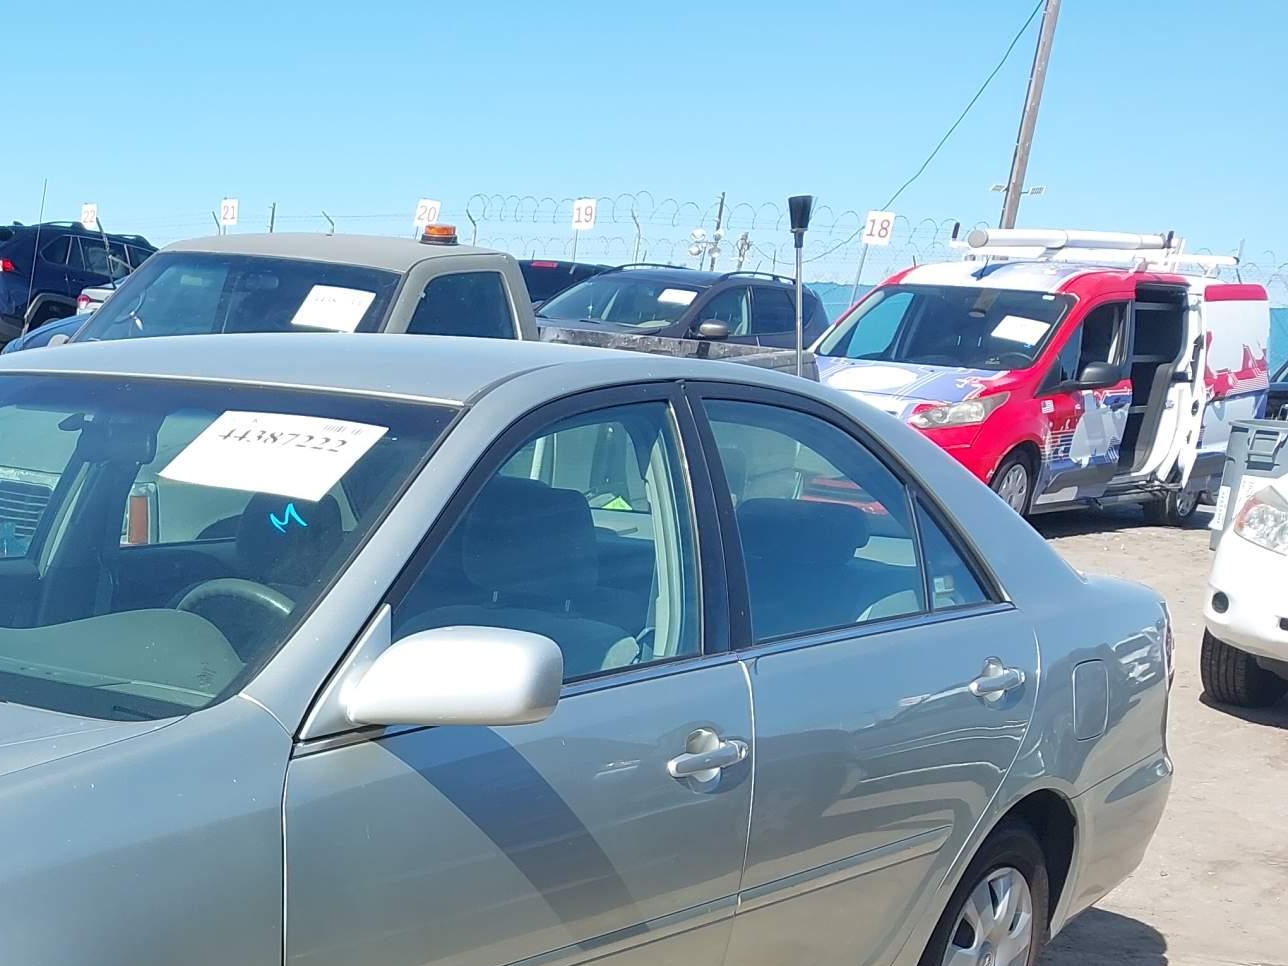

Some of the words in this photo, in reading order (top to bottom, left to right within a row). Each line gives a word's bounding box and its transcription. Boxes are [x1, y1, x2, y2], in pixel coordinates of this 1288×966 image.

[83, 209, 97, 224] 22
[223, 204, 236, 220] 21
[418, 204, 437, 221] 20
[574, 205, 594, 223] 19
[865, 217, 891, 238] 18
[218, 428, 349, 452] 44387222
[269, 502, 309, 534] M
